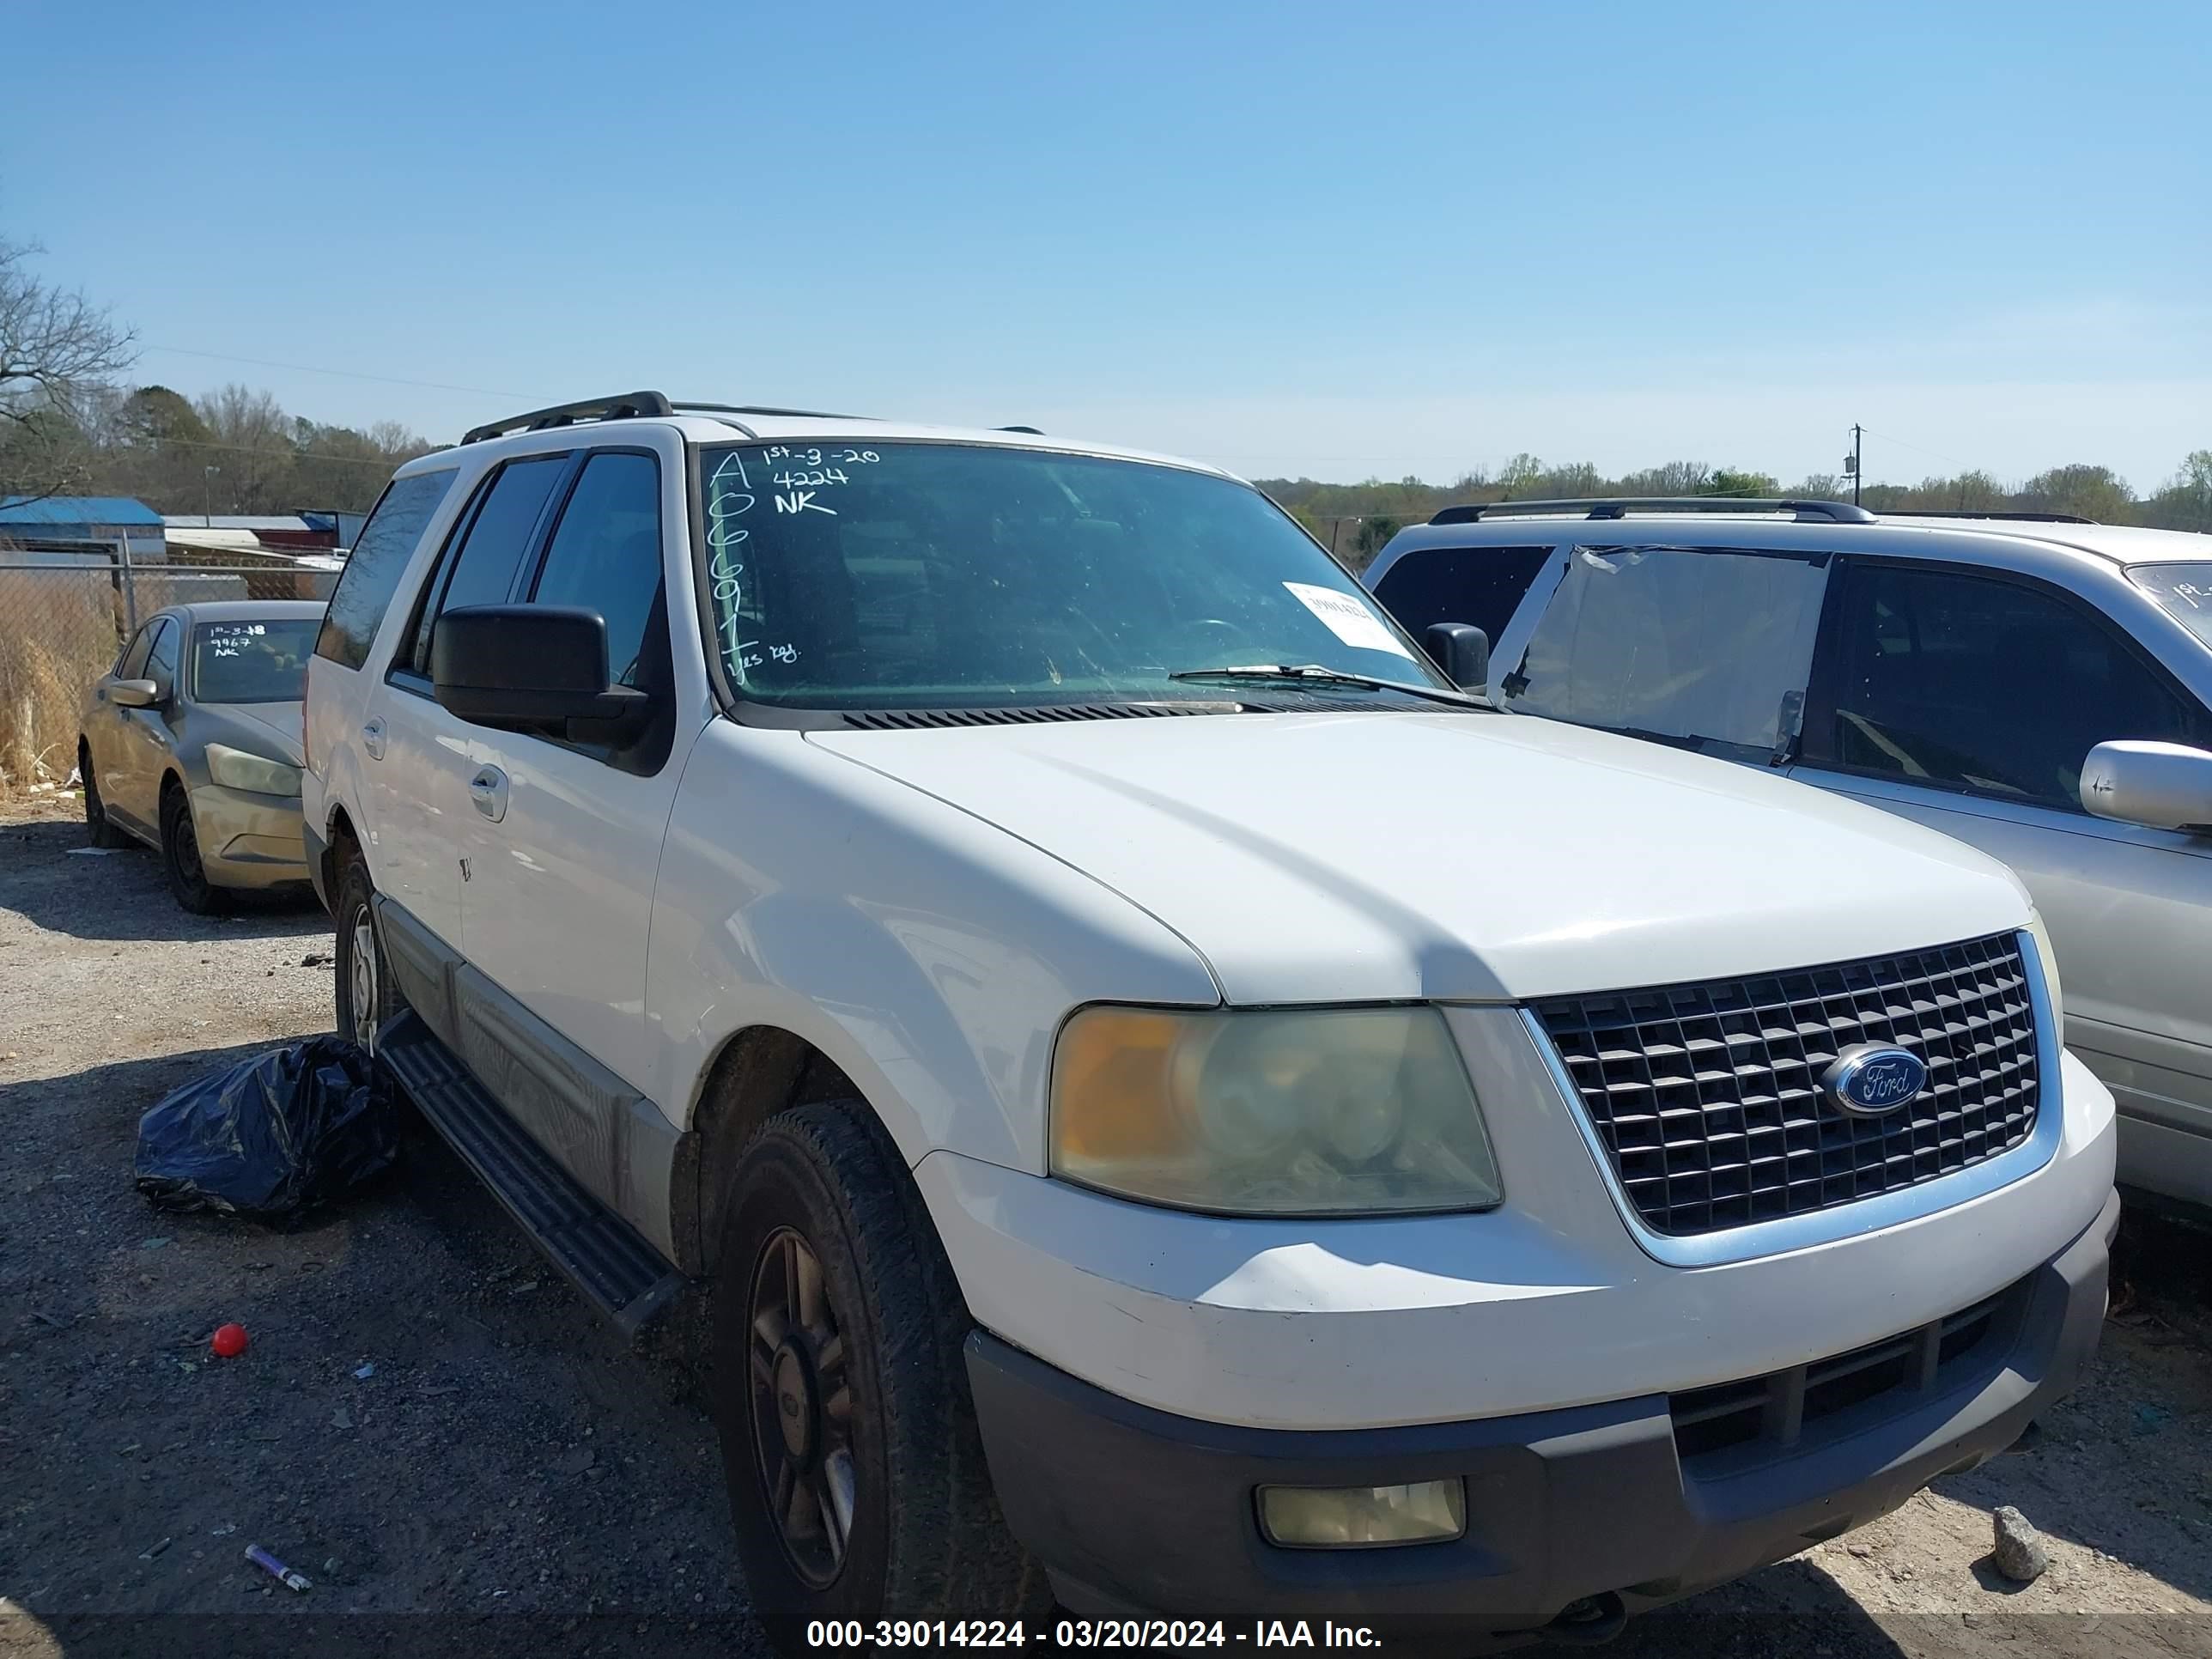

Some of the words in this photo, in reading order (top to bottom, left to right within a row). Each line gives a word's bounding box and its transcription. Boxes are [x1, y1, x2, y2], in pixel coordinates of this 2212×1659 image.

[774, 468, 849, 490] 4224
[775, 491, 838, 516] NK
[215, 647, 240, 658] NK
[1863, 1063, 1910, 1101] Ford
